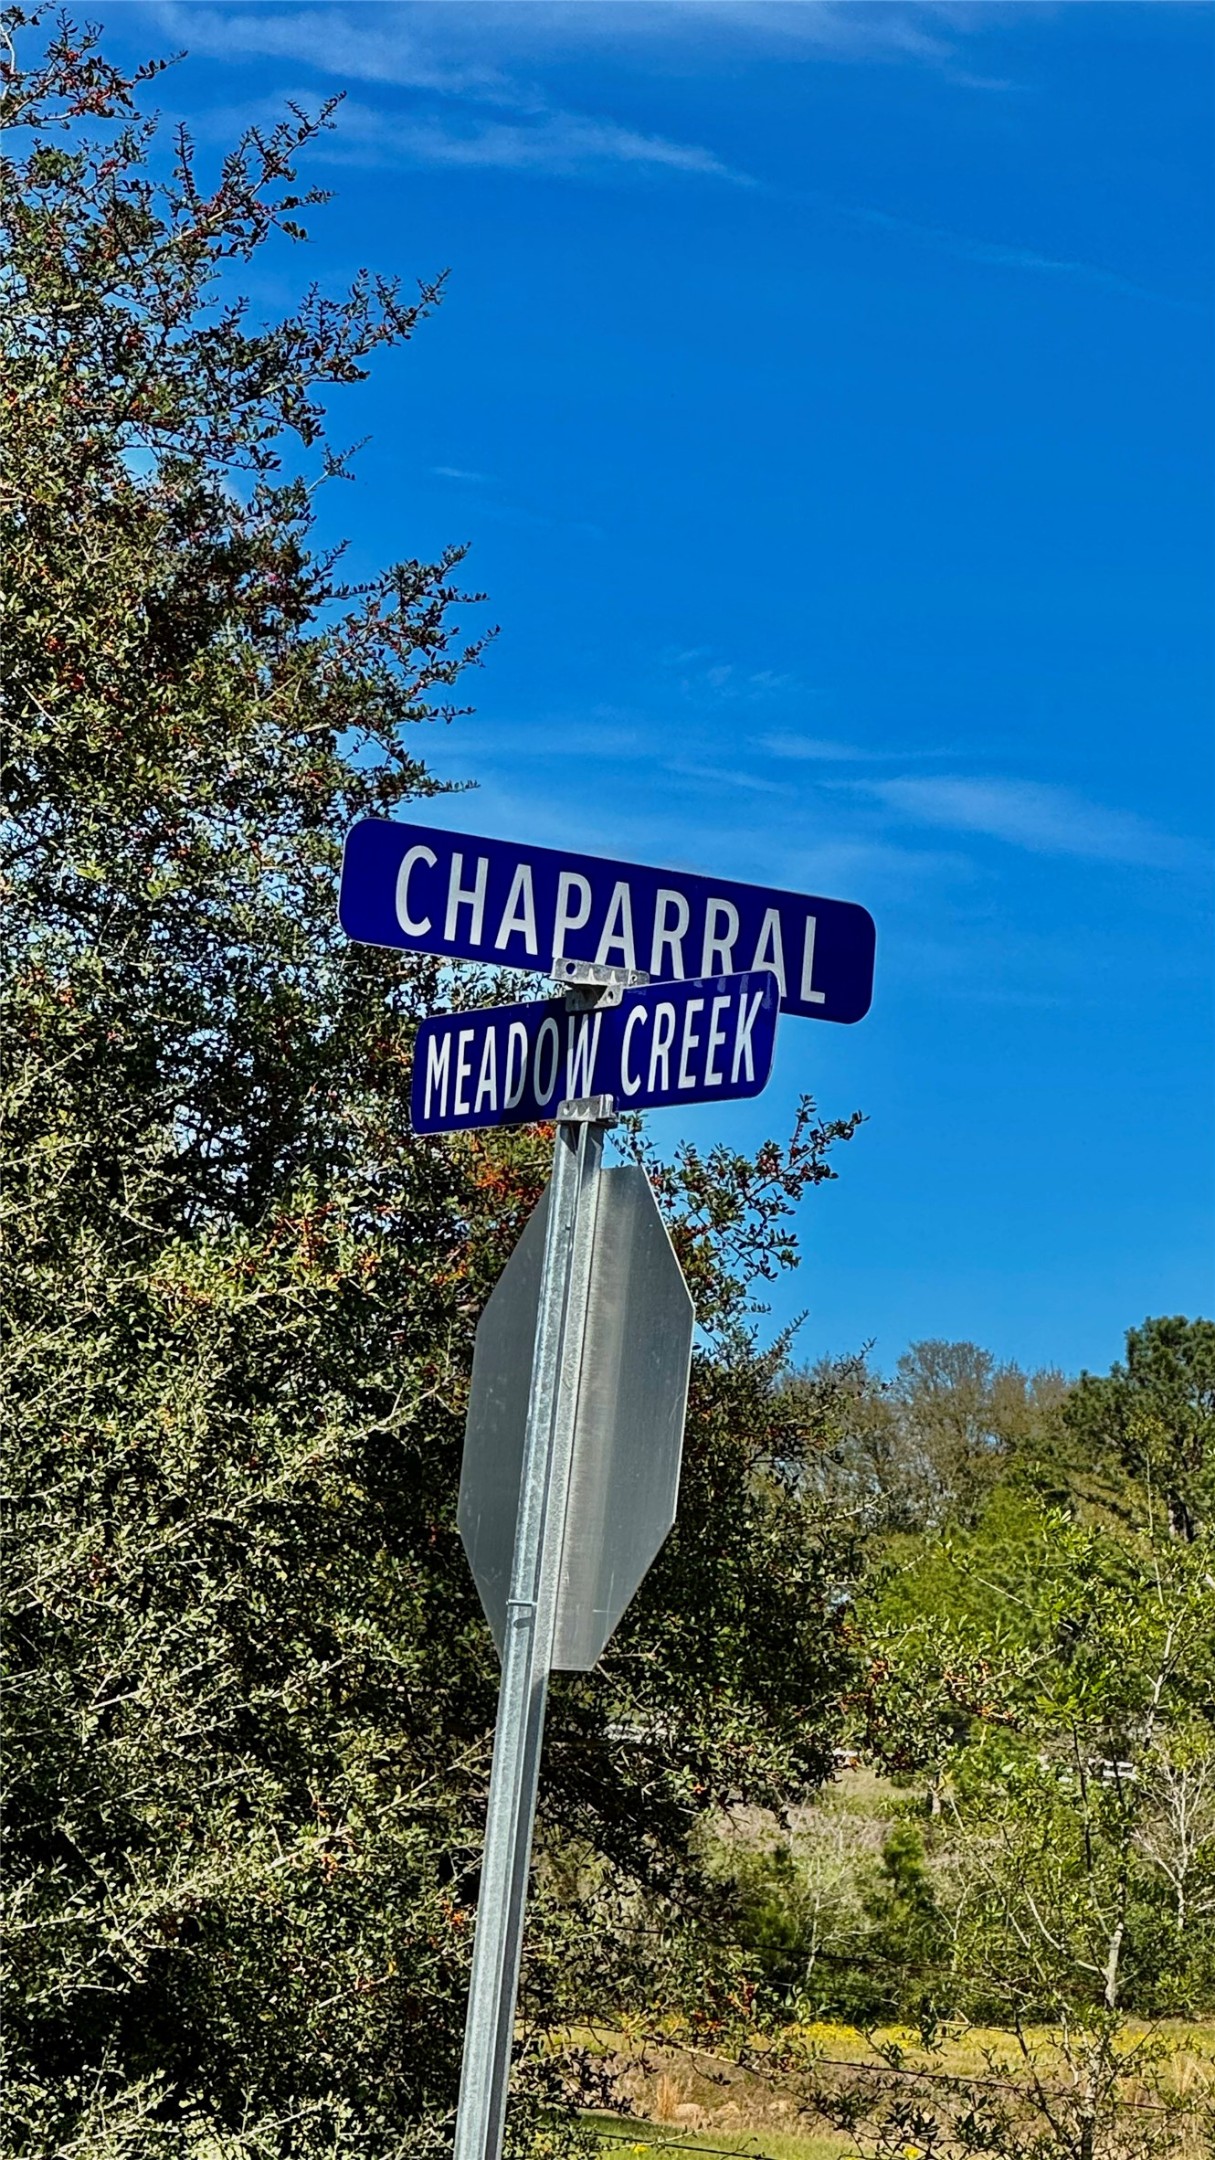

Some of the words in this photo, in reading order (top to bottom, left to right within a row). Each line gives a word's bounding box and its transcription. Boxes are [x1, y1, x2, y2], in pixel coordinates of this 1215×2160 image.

[395, 844, 826, 1004] CHAPARRAL
[423, 1011, 603, 1120] MEADOW
[620, 989, 764, 1096] CREEK
